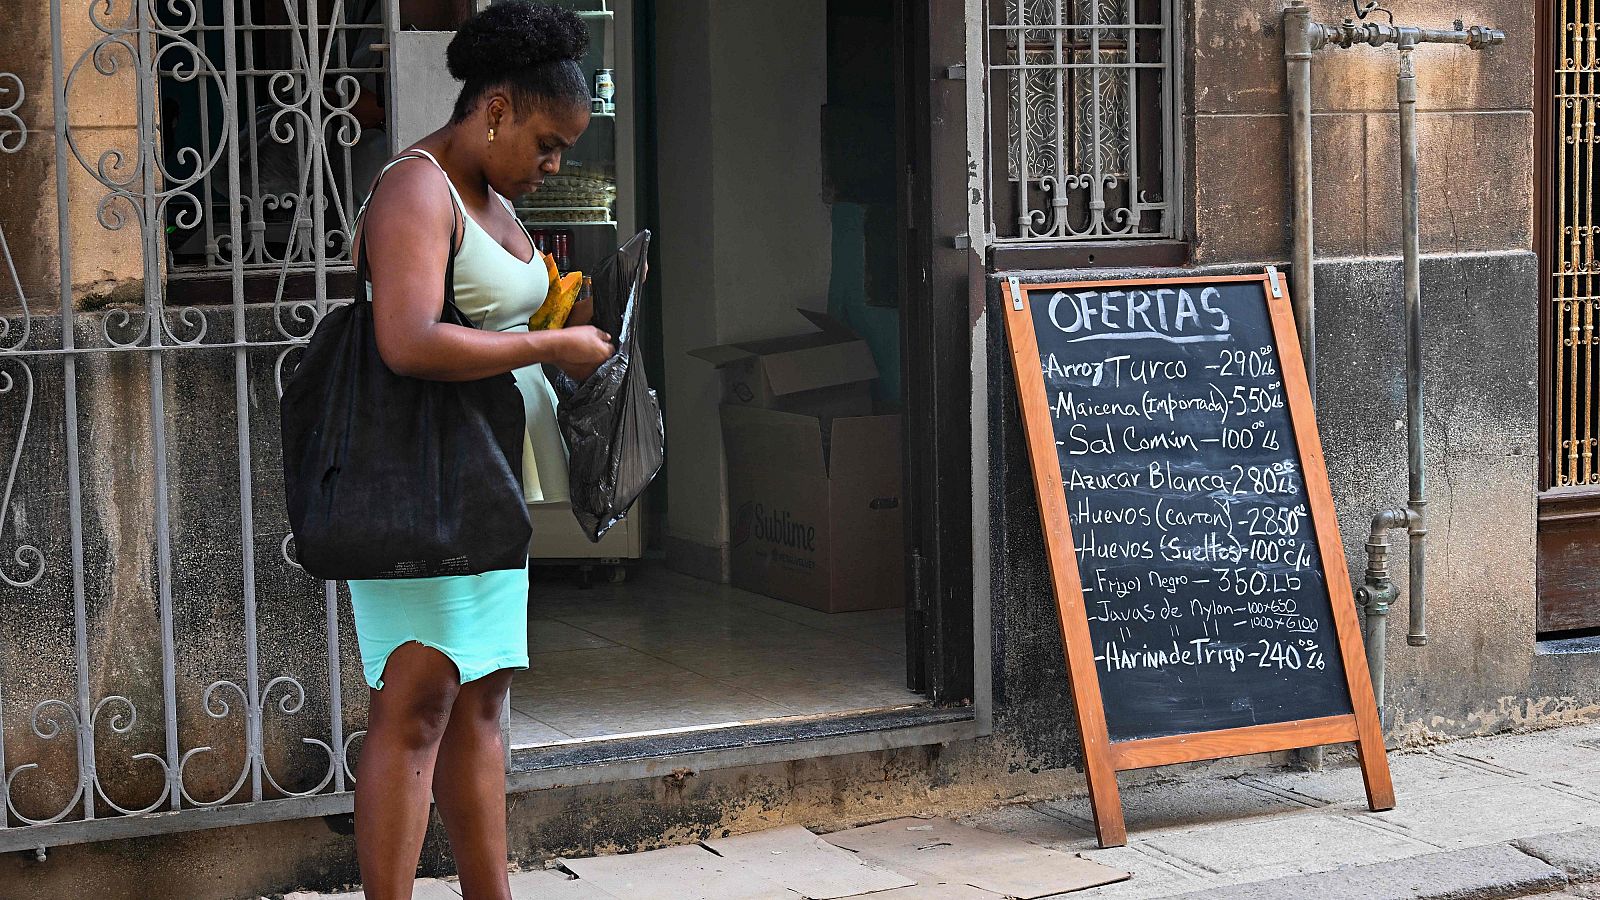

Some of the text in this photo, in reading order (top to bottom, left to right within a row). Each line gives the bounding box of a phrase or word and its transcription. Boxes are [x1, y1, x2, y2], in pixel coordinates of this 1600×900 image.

[1048, 286, 1230, 333] OFERTAS
[1104, 355, 1187, 388] Turco
[1149, 461, 1228, 493] Blanca
[754, 503, 815, 552] Sublime
[1159, 597, 1182, 620] de
[1189, 637, 1245, 672] Trigo
